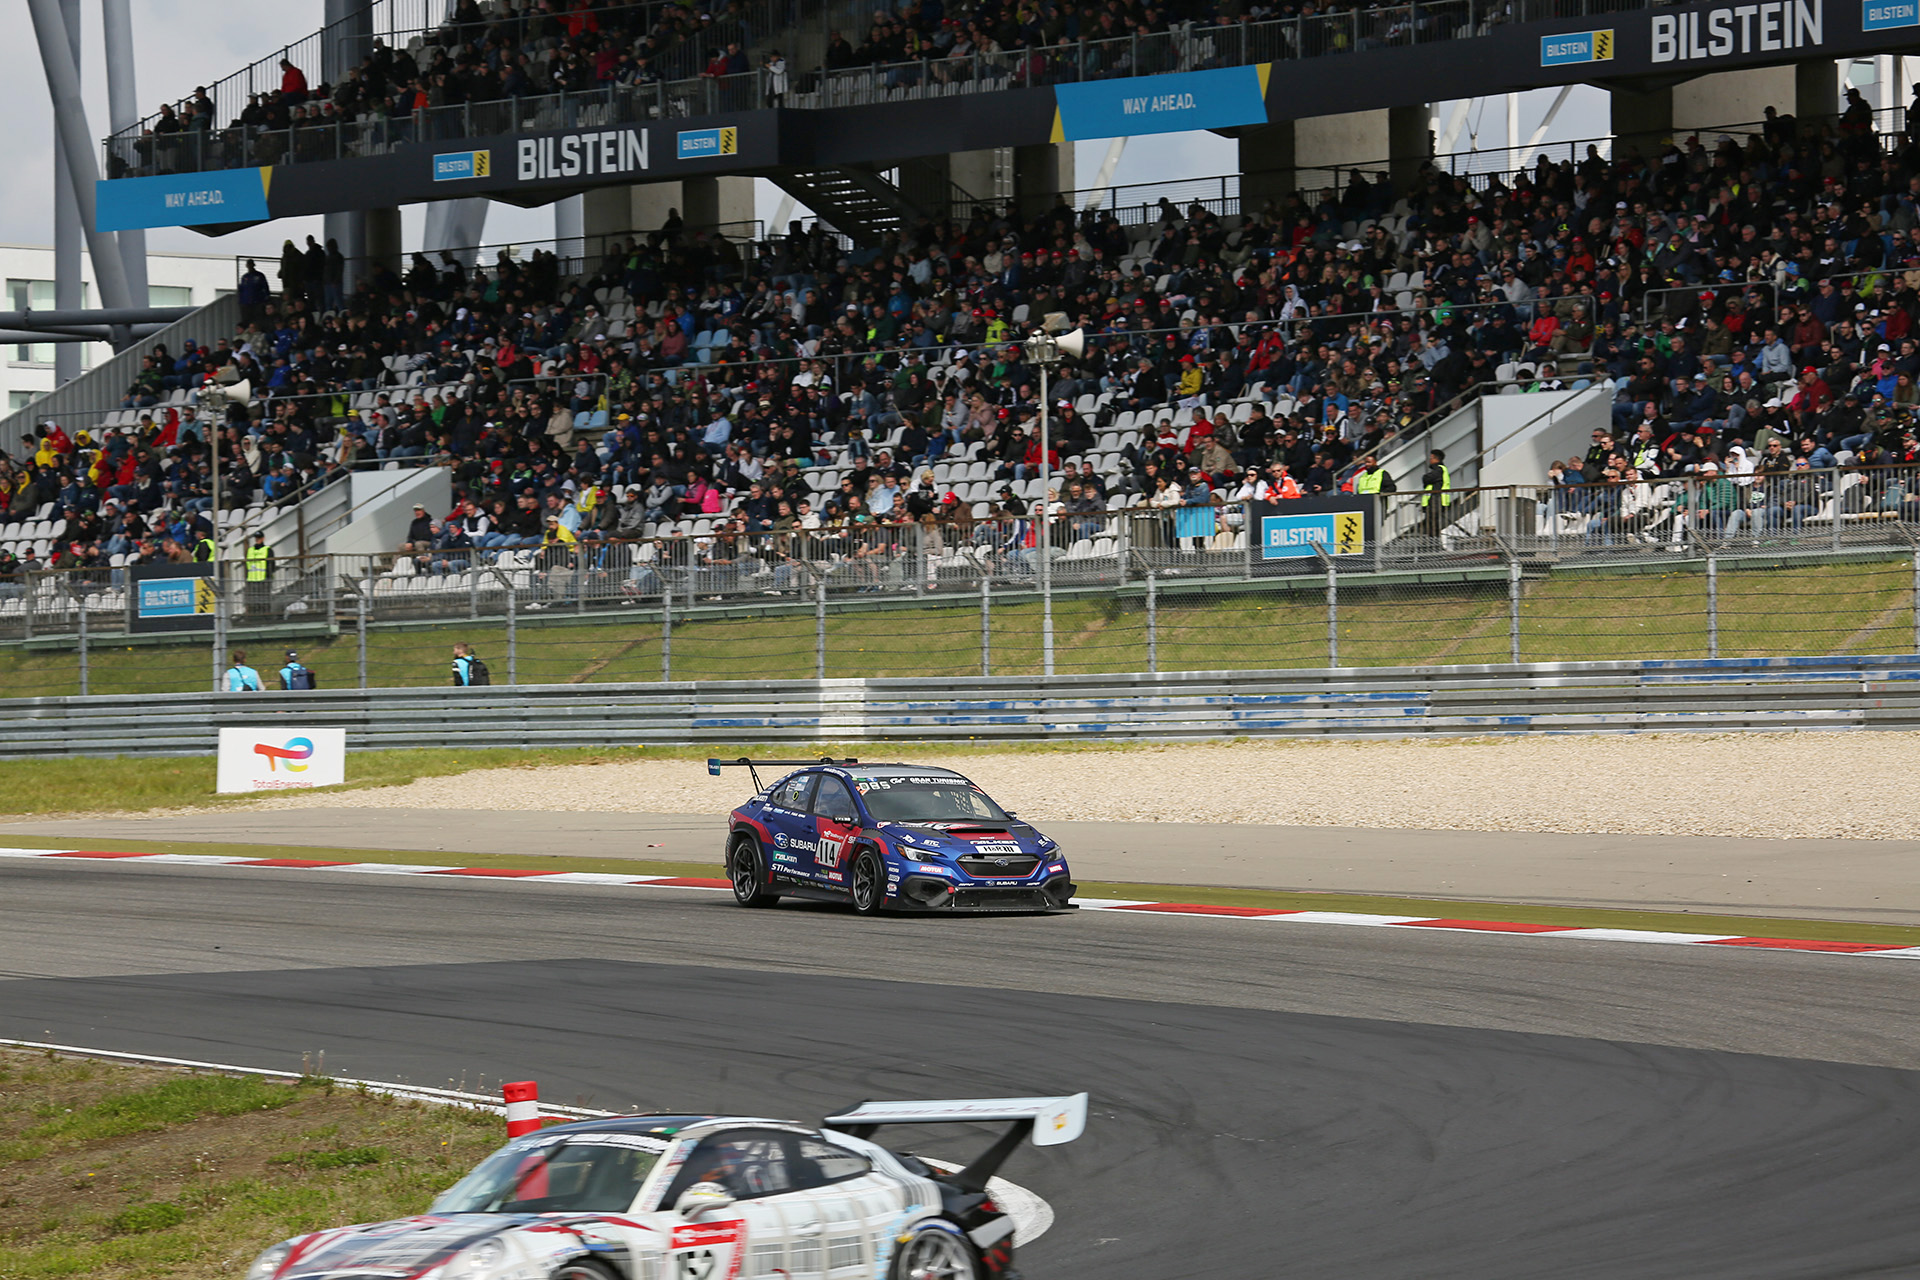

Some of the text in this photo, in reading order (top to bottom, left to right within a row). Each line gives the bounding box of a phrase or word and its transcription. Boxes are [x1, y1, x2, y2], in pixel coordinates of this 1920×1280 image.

[1869, 4, 1914, 21] BILSTEIN
[1651, 0, 1823, 63] BILSTEIN
[1546, 41, 1588, 57] BILSTEIN
[1123, 92, 1196, 115] WAY AHEAD.
[682, 136, 717, 151] BILSTEIN
[517, 128, 648, 181] BILSTEIN
[437, 158, 470, 174] BILSTEIN
[165, 189, 224, 208] WAY AHEAD.
[1270, 527, 1328, 546] BILSTEIN
[144, 589, 190, 606] BILSTEIN
[252, 779, 313, 789] TotalEnergies
[790, 838, 817, 852] SUBARU
[819, 840, 836, 866] 114
[775, 853, 798, 863] FALKEN
[771, 863, 784, 872] STI
[784, 867, 811, 878] Performance
[920, 865, 943, 873] MOTUL
